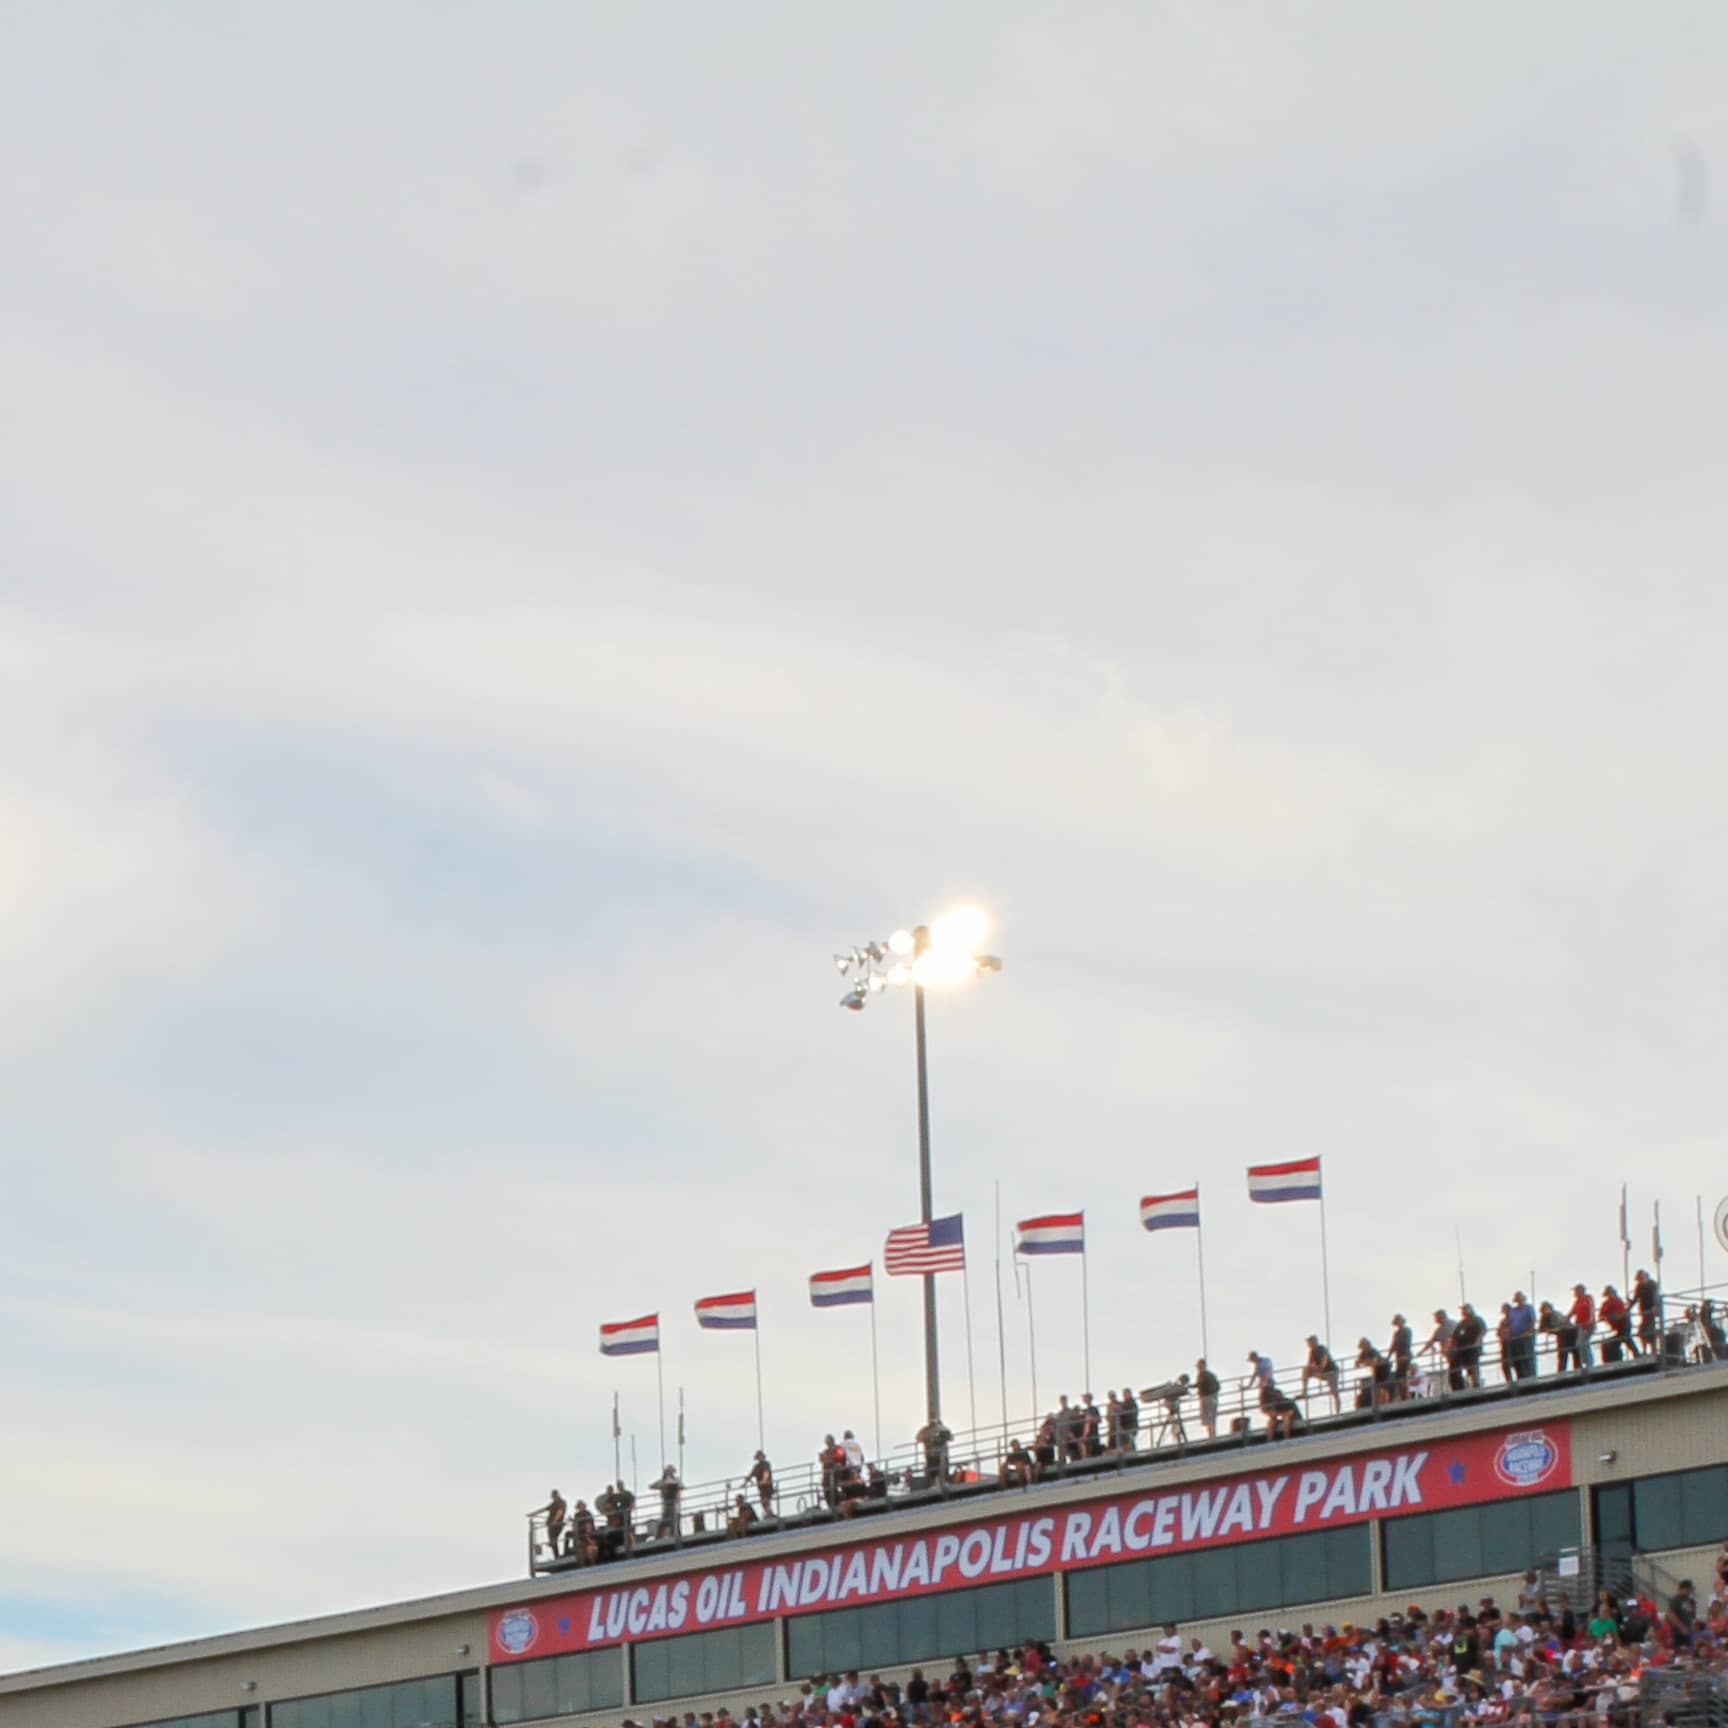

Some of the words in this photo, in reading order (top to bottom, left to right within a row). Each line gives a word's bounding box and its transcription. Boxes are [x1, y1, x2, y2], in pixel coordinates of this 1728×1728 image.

[587, 1574, 690, 1643] LUCAS
[695, 1570, 748, 1622] OIL
[757, 1516, 1056, 1613] INDIANAPOLIS
[1060, 1475, 1290, 1562] RACEWAY
[1293, 1451, 1429, 1524] PARK
